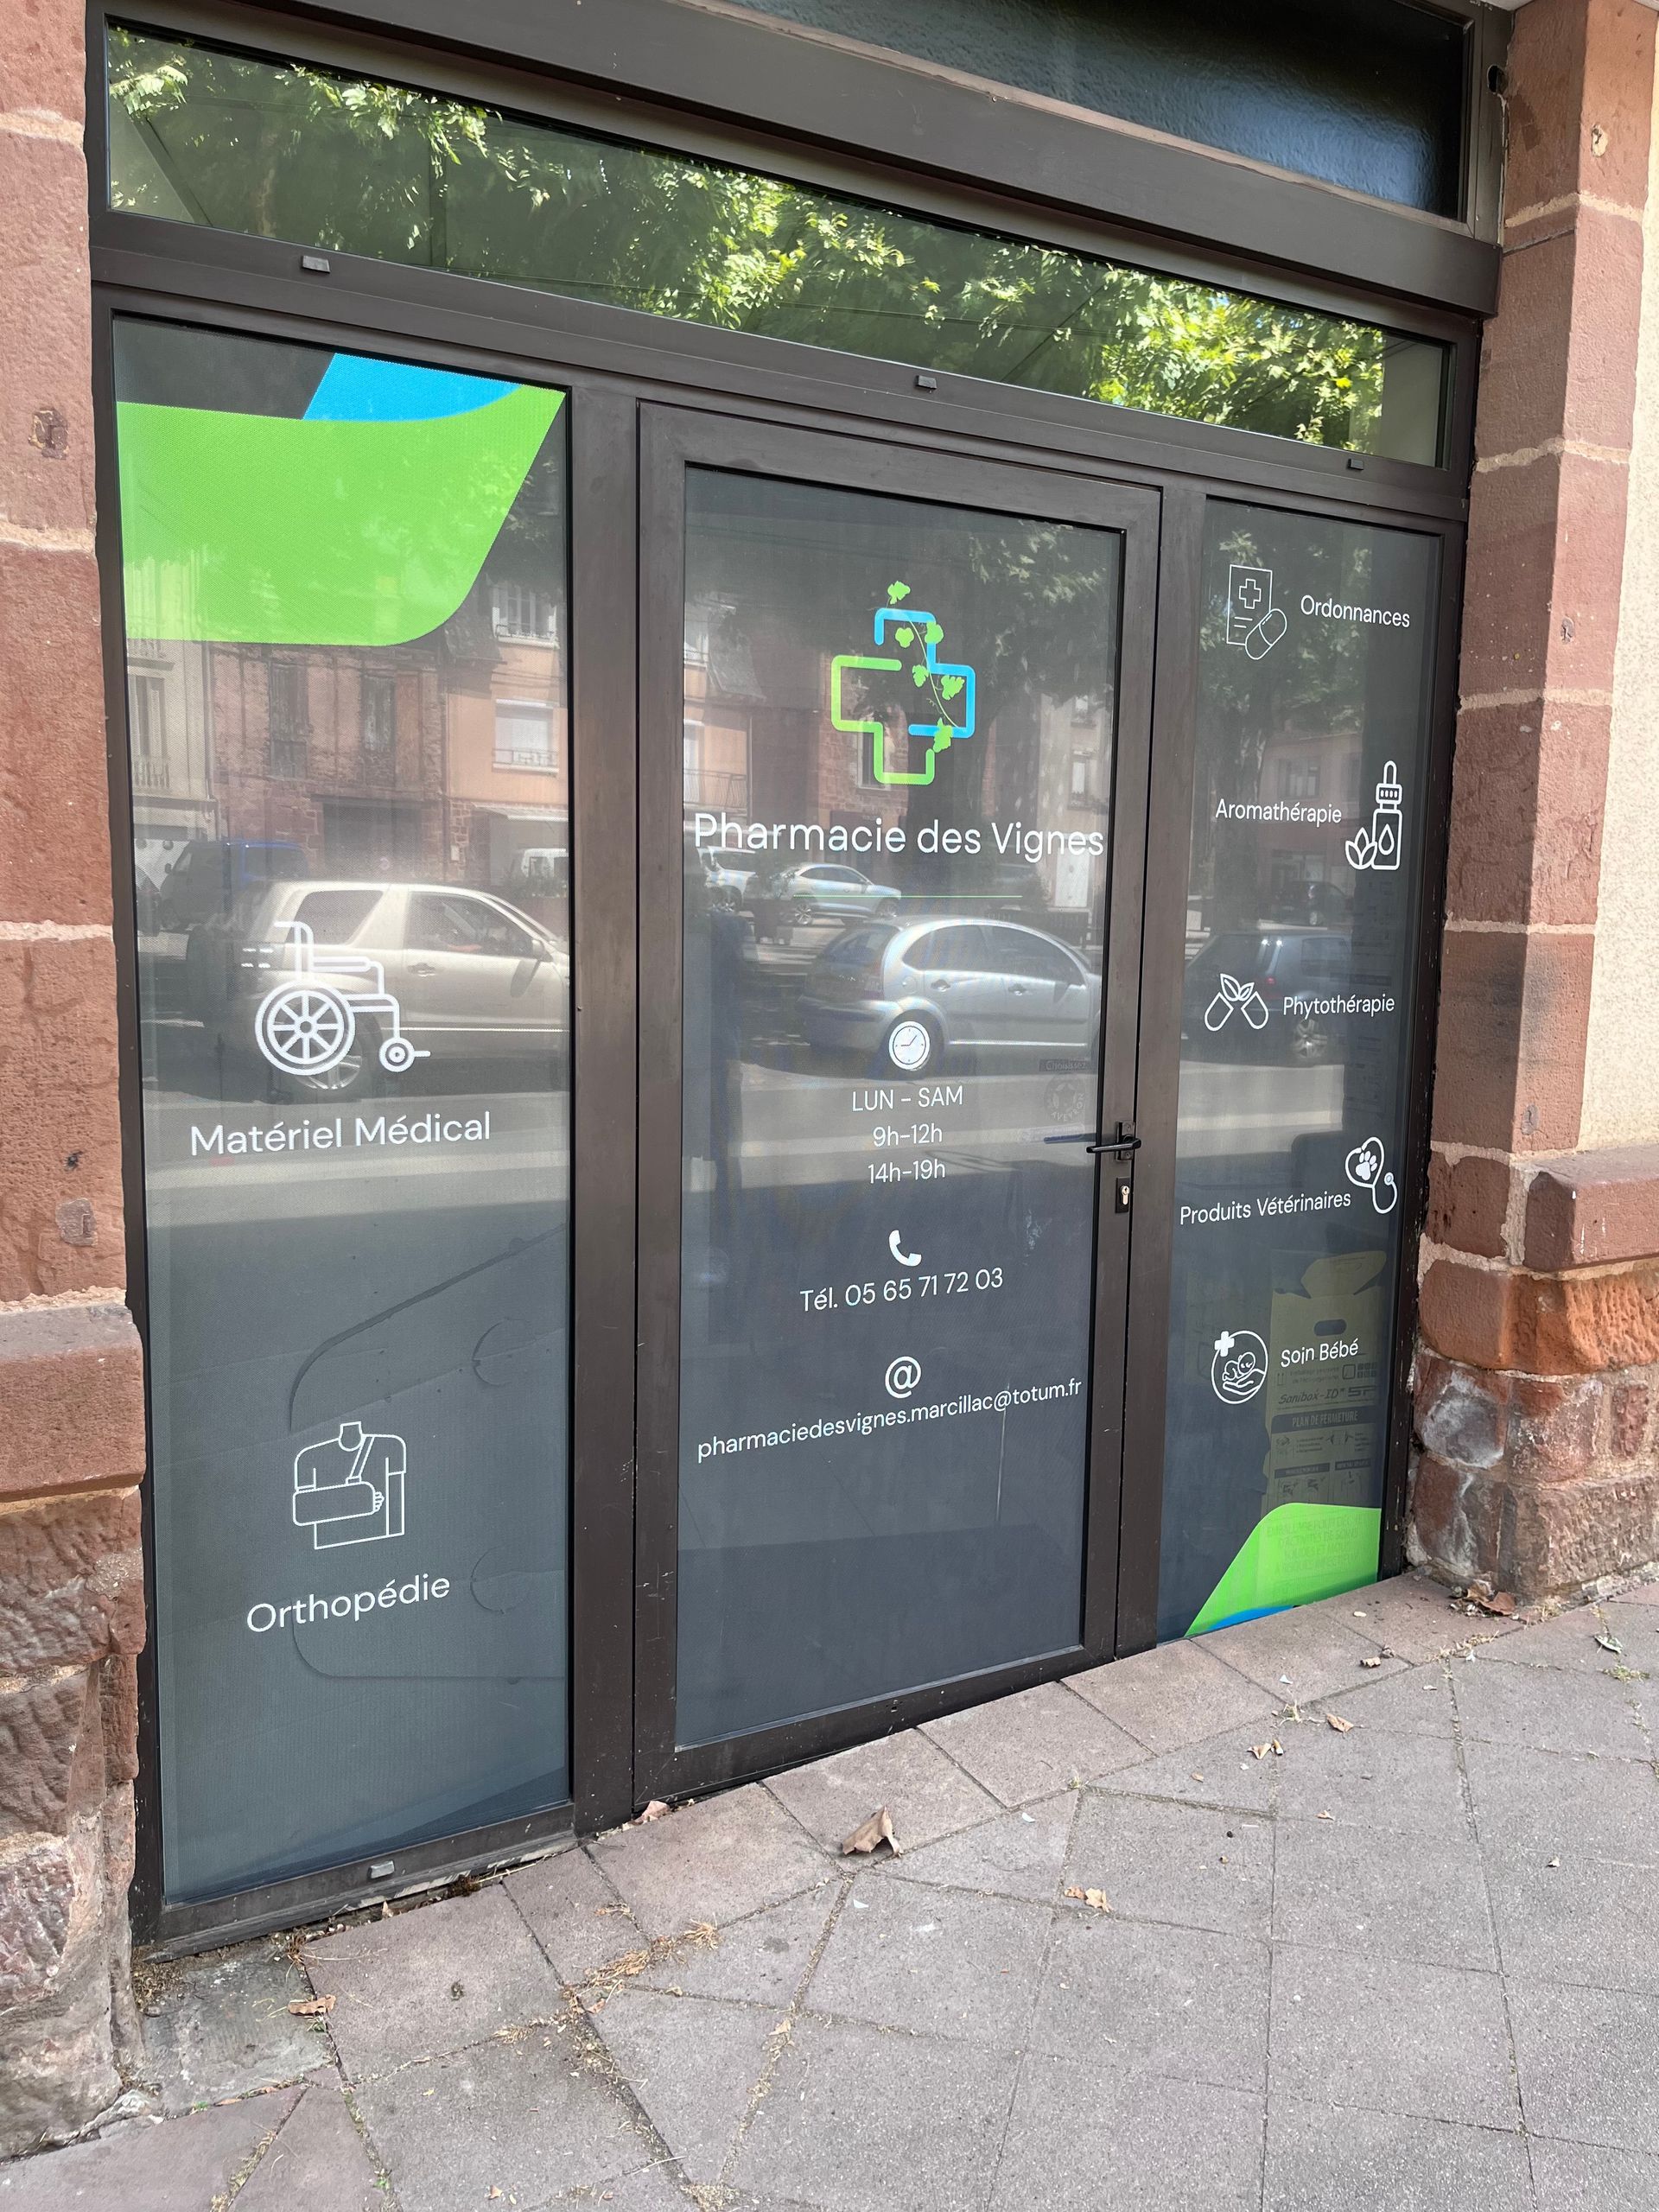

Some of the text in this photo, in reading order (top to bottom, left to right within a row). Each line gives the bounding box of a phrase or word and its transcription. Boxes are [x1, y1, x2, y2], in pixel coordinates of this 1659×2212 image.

[1301, 594, 1410, 628] Ordonnances
[1216, 798, 1342, 824] Aromathérapie
[695, 812, 1104, 863] Pharmacie des Vignes
[1283, 994, 1395, 1020] Phytothérapie
[852, 1089, 894, 1112] LUN
[918, 1084, 963, 1108] SAM
[191, 1110, 490, 1156] Matériel Médical
[873, 1123, 943, 1147] 9h-12h
[868, 1159, 945, 1184] 14h-19h
[1180, 1190, 1351, 1225] Produits Vétérinaires
[800, 1267, 1003, 1312] Tél. 05 65 71 72 03
[1281, 1338, 1359, 1369] Soin Bébé
[885, 1357, 922, 1399] @
[696, 1377, 1083, 1463] pharmaciedesvignes.marcillac@totum.fr
[1292, 1409, 1358, 1428] PLAN DE FERMETURE
[246, 1573, 450, 1633] Orthopédie
